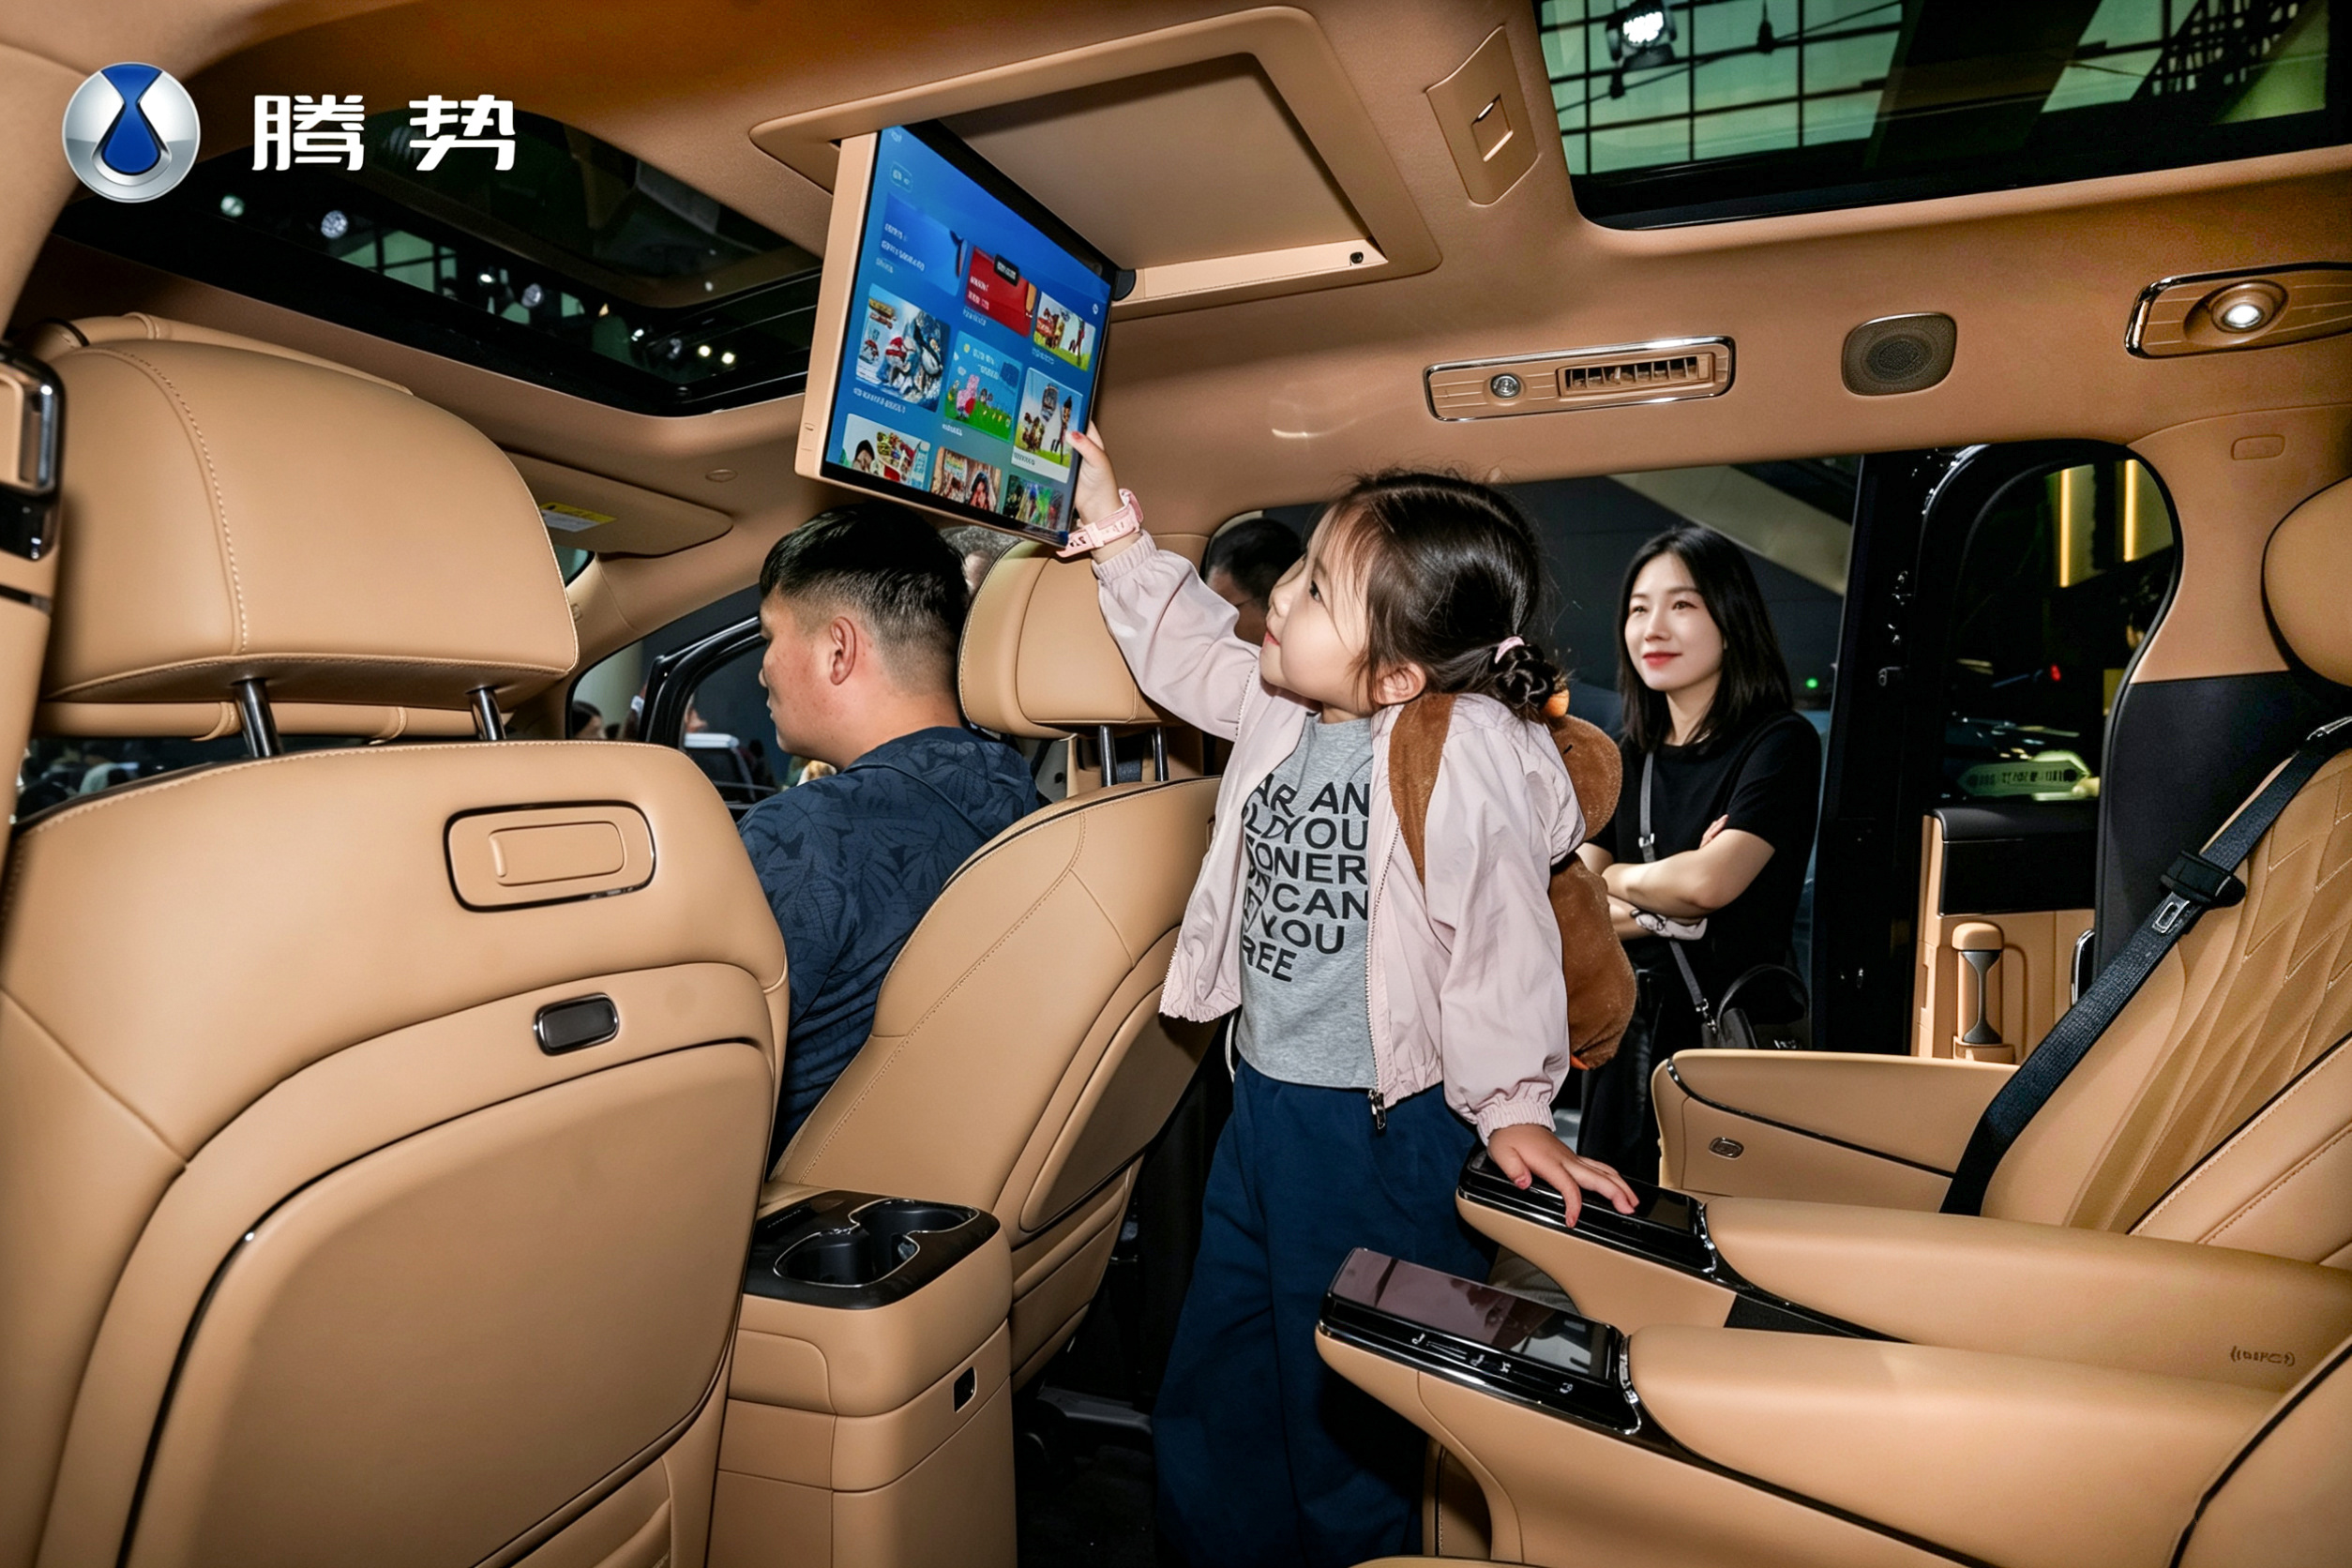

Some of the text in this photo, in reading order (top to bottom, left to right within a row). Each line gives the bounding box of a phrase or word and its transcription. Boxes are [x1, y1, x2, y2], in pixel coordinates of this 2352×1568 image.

[1242, 802, 1368, 852] LD YOU
[1273, 882, 1368, 921] CAN
[1261, 908, 1345, 955] YOU
